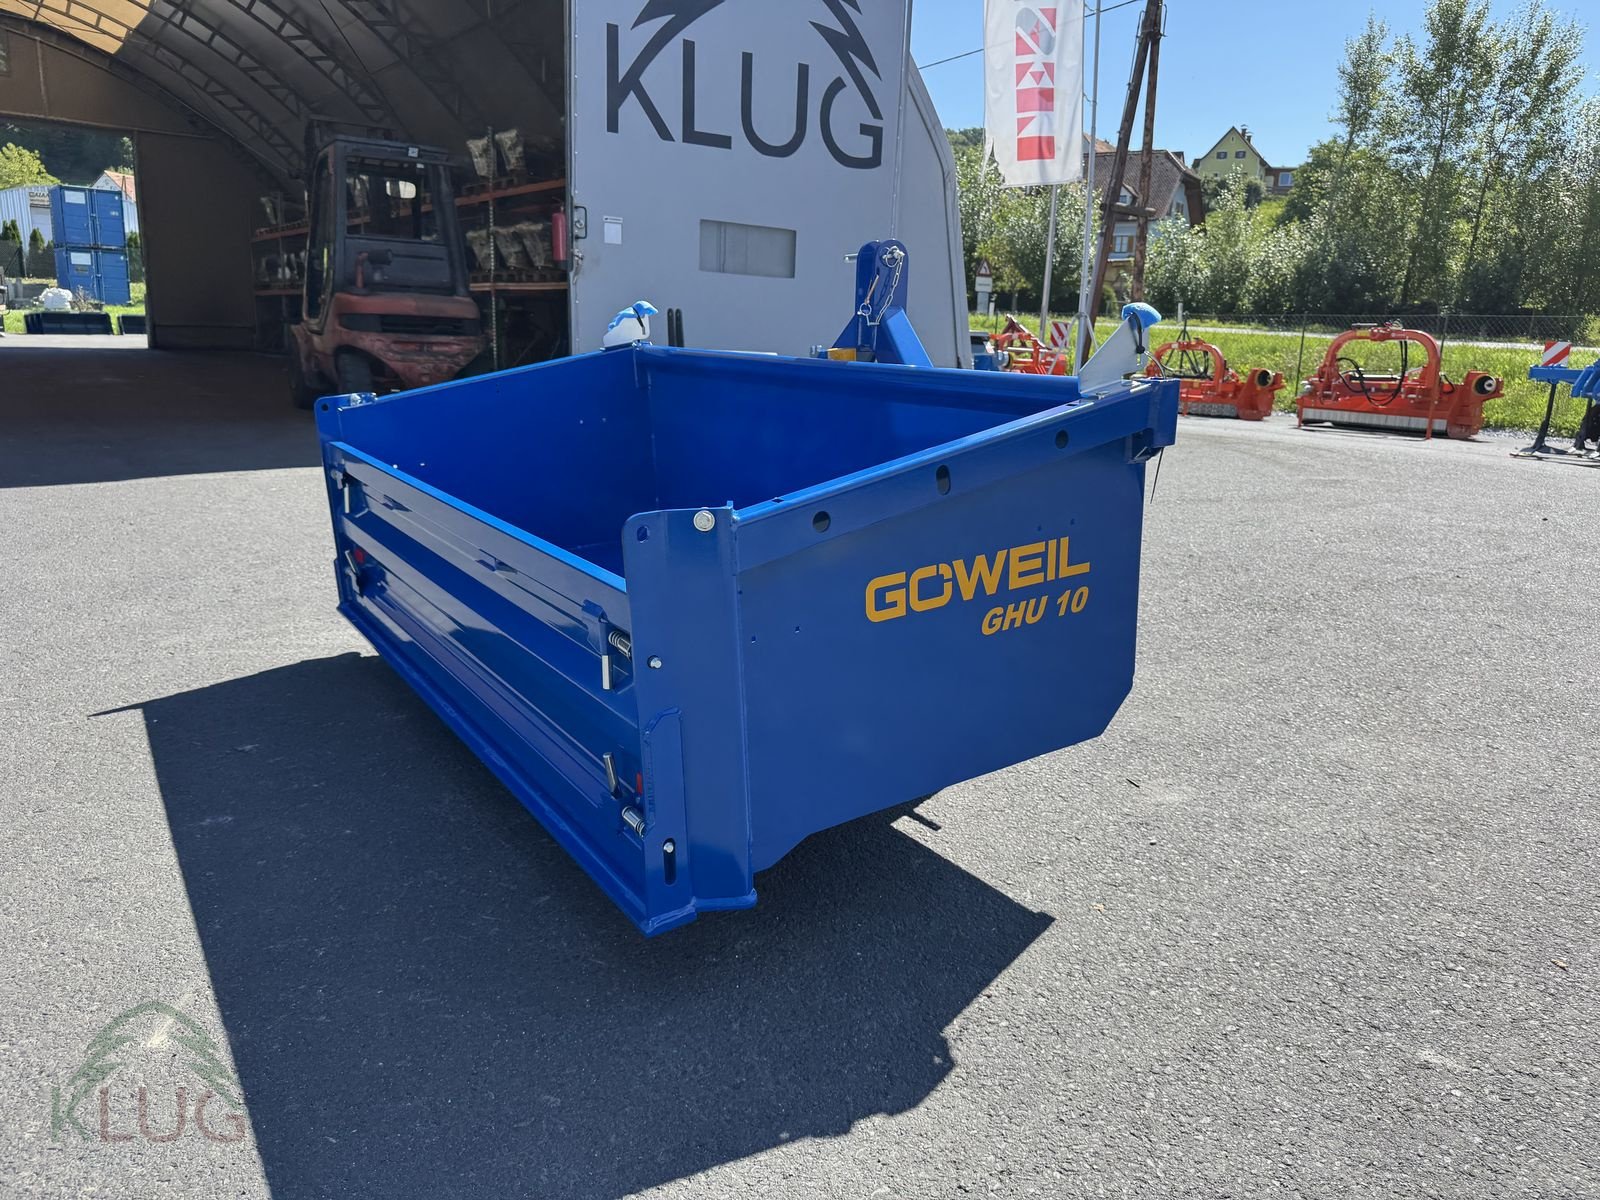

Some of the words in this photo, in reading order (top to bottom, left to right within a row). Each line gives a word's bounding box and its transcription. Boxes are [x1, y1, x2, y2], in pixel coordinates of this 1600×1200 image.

[606, 22, 883, 169] KLUG
[982, 596, 1048, 635] GHU
[1057, 587, 1089, 616] 10
